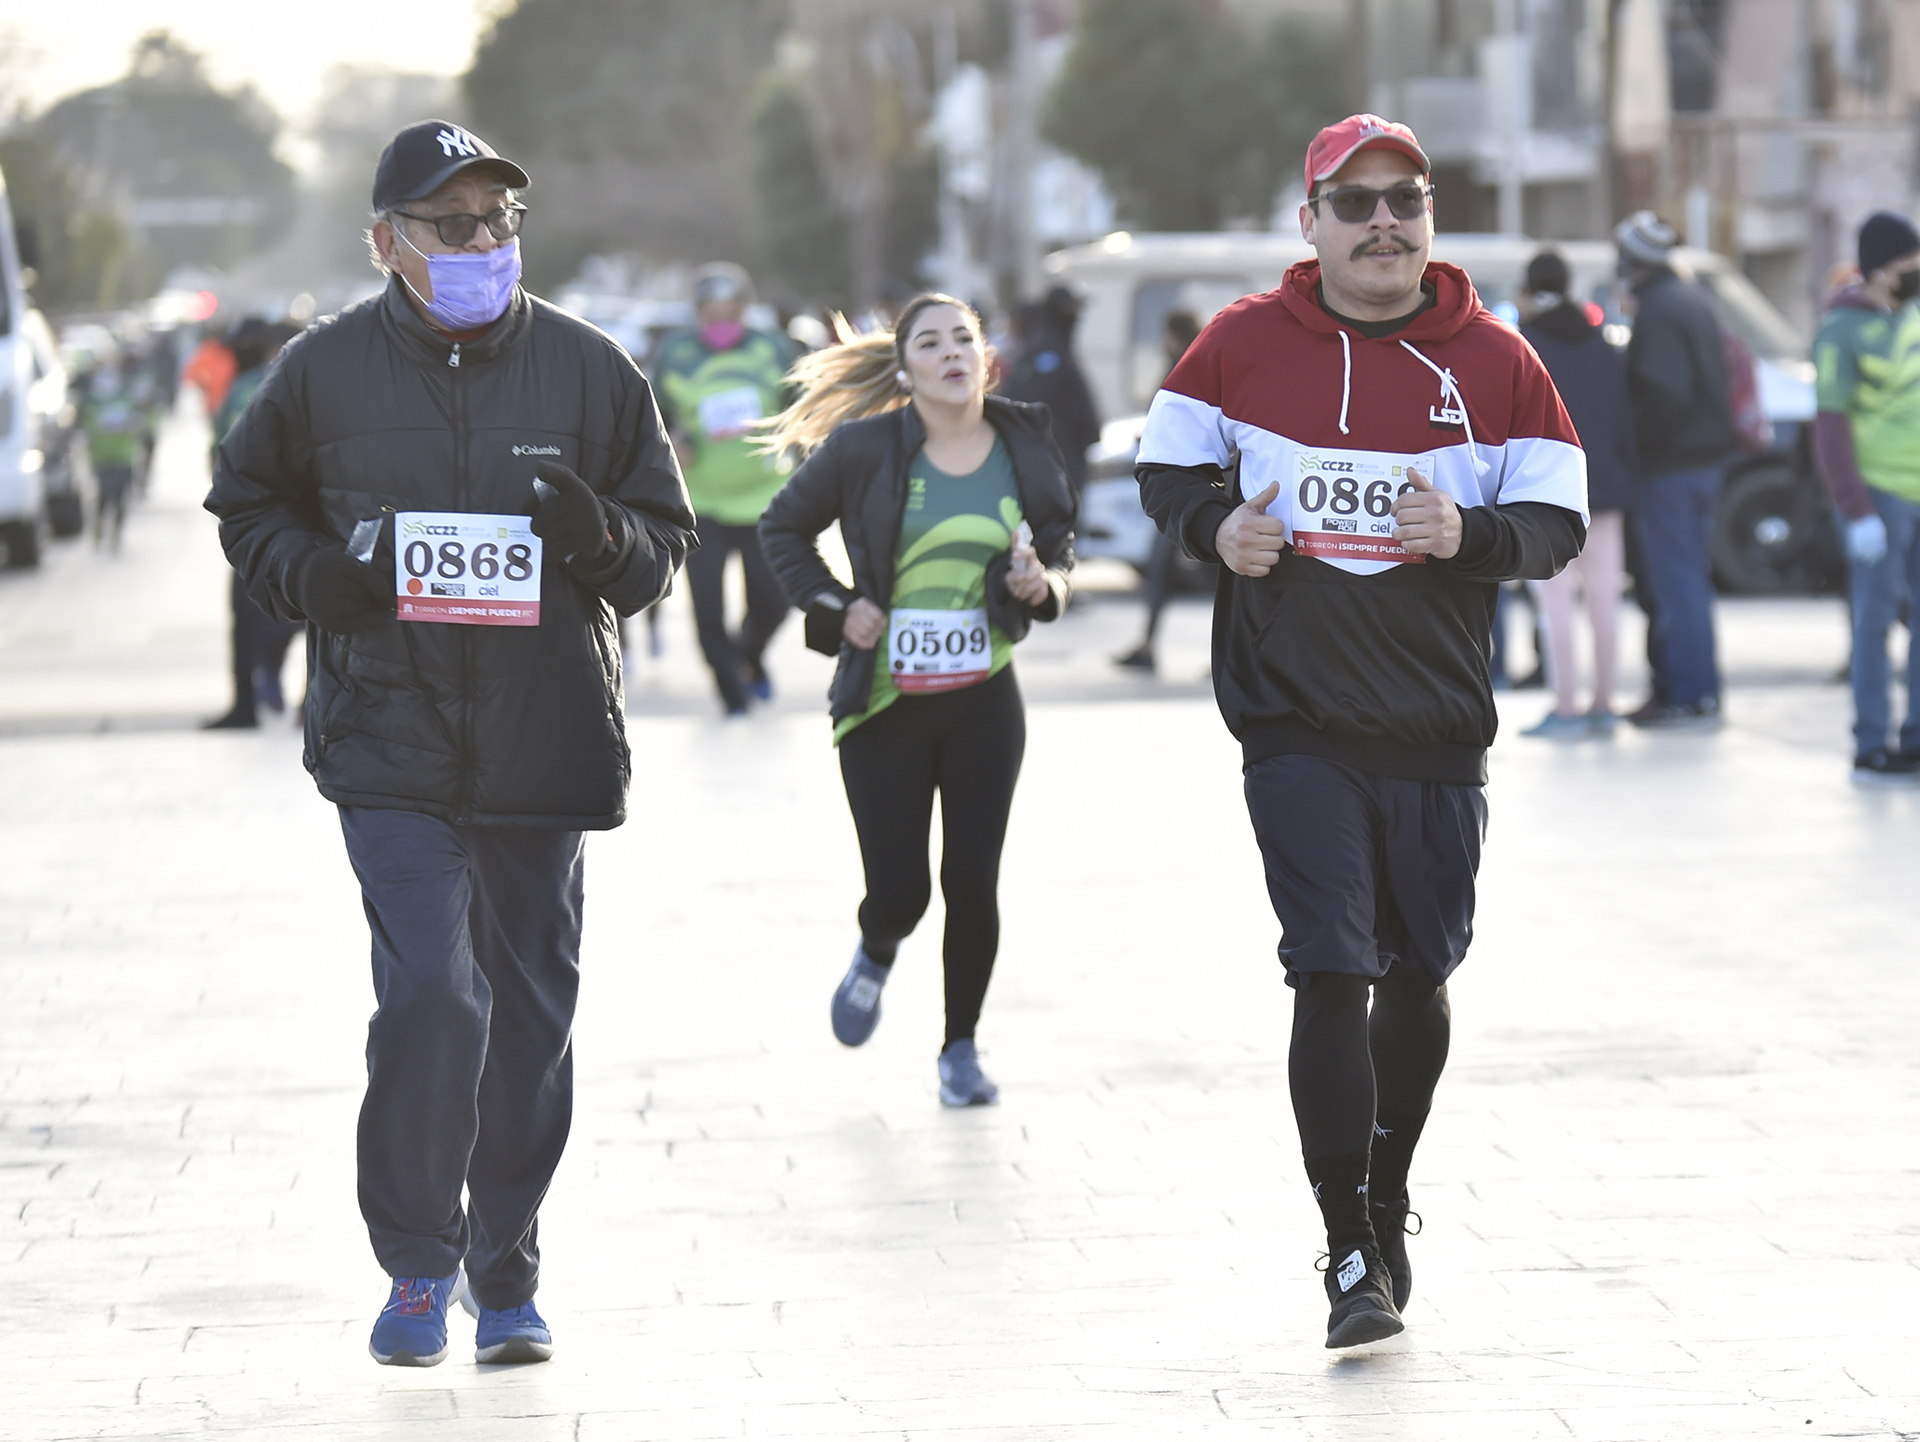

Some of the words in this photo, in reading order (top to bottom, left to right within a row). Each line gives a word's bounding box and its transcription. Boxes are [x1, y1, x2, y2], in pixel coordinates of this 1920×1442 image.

[521, 444, 562, 456] Columbia
[1321, 461, 1354, 473] CCZZ
[426, 525, 459, 536] CCZZ
[1370, 520, 1390, 534] ciel
[404, 540, 534, 581] 0868
[478, 583, 500, 597] ciel
[896, 626, 986, 657] 0509
